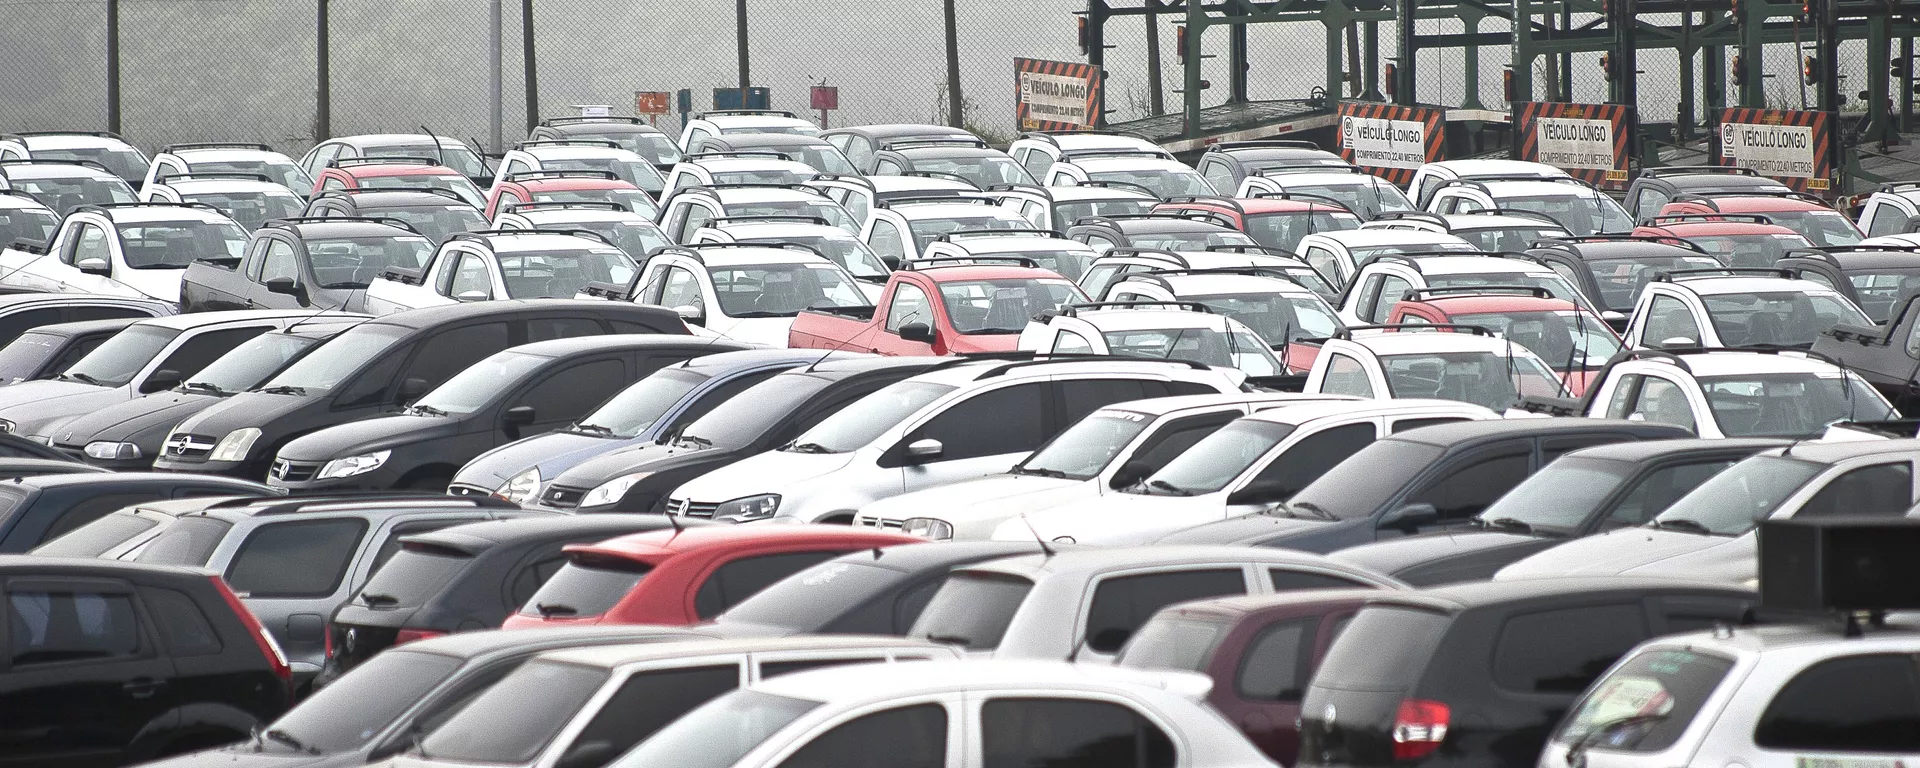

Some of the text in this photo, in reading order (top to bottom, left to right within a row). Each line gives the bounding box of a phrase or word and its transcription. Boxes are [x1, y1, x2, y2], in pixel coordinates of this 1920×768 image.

[1030, 77, 1060, 98] VEÍCULO
[1061, 83, 1085, 100] LONGO
[1357, 122, 1421, 144] VEÍCULO LONGO
[1543, 120, 1606, 142] VEÍCULO LONGO
[1741, 126, 1807, 149] VEÍCULO LONGO
[1356, 149, 1392, 162] COMPRIMENTO
[1404, 153, 1424, 163] METROS
[1540, 151, 1577, 164] COMPRIMENTO
[1590, 154, 1613, 166] METROS
[1738, 158, 1776, 172] COMPRIMENTO
[1789, 162, 1813, 174] METROS
